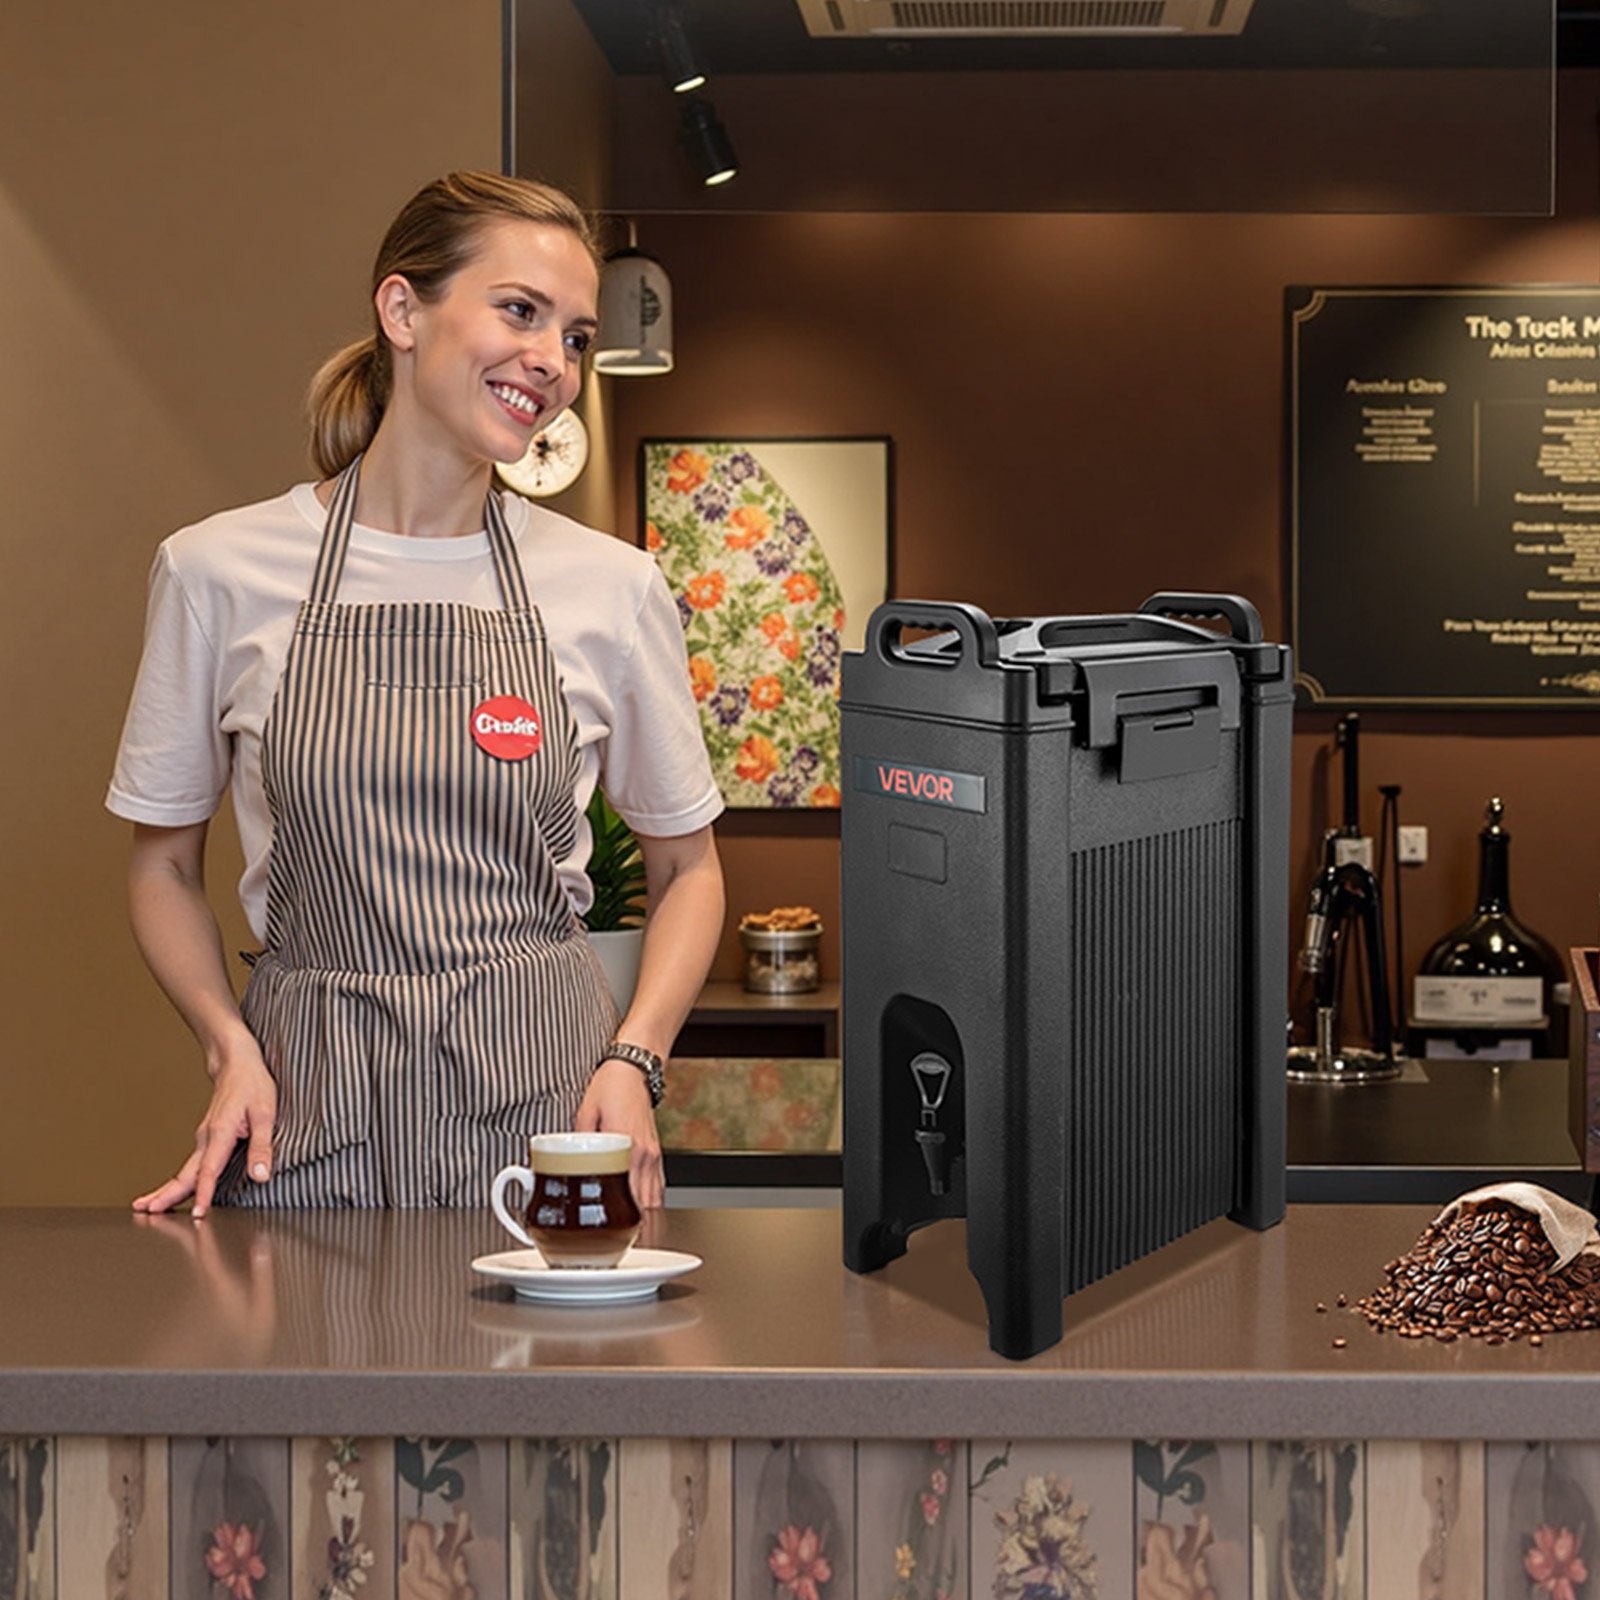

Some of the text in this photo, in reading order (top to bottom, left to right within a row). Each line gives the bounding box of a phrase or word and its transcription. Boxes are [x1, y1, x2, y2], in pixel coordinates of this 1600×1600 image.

[1465, 315, 1512, 339] The
[1515, 315, 1577, 339] Tuck
[878, 766, 956, 803] VEVOR
